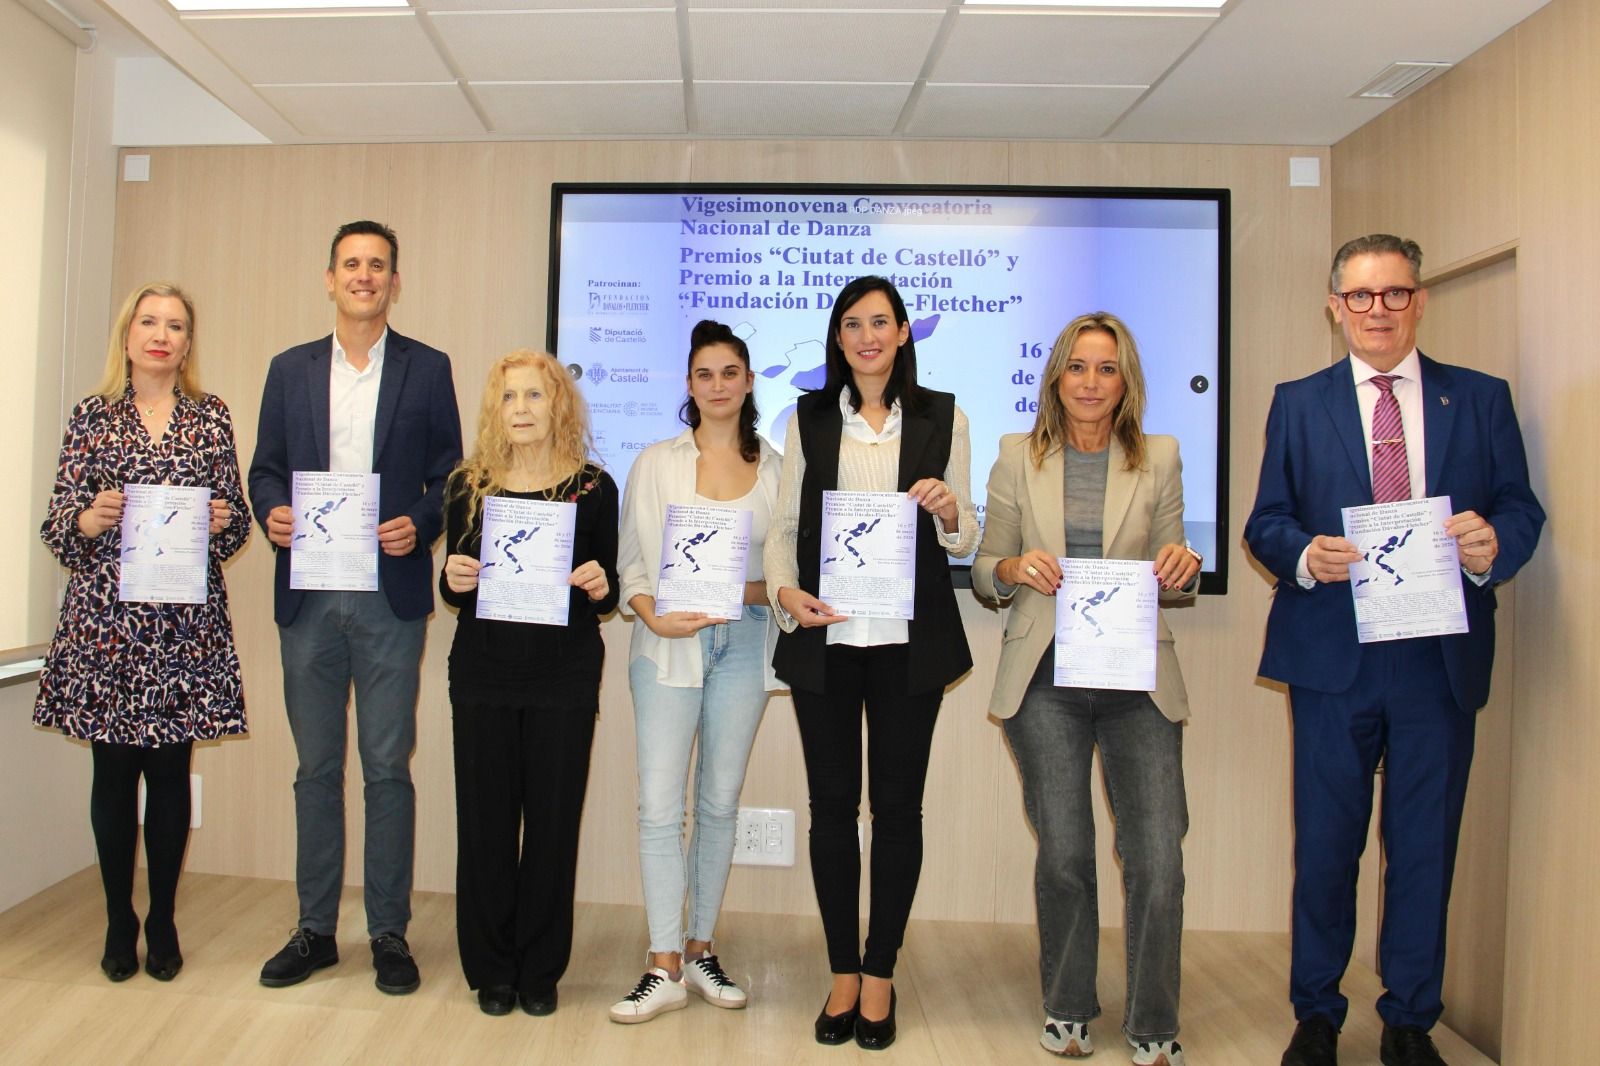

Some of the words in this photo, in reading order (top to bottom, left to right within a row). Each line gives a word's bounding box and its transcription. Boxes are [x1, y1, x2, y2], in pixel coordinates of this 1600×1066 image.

[682, 196, 848, 217] Vigesimonovena
[853, 197, 993, 216] Convocatoria
[680, 219, 770, 236] Nacional
[777, 220, 801, 236] de
[807, 221, 872, 237] Danza
[680, 247, 762, 264] Premios
[769, 246, 855, 265] “Ciutat
[861, 248, 888, 266] de
[895, 248, 1000, 267] Castelló”
[1006, 255, 1019, 272] y
[588, 279, 642, 288] Patrocinan:
[680, 269, 753, 286] Premio
[759, 274, 770, 286] a
[777, 270, 796, 286] la
[678, 290, 809, 310] “Fundación
[1020, 342, 1043, 359] 16
[1011, 369, 1035, 385] de
[1015, 397, 1038, 413] de
